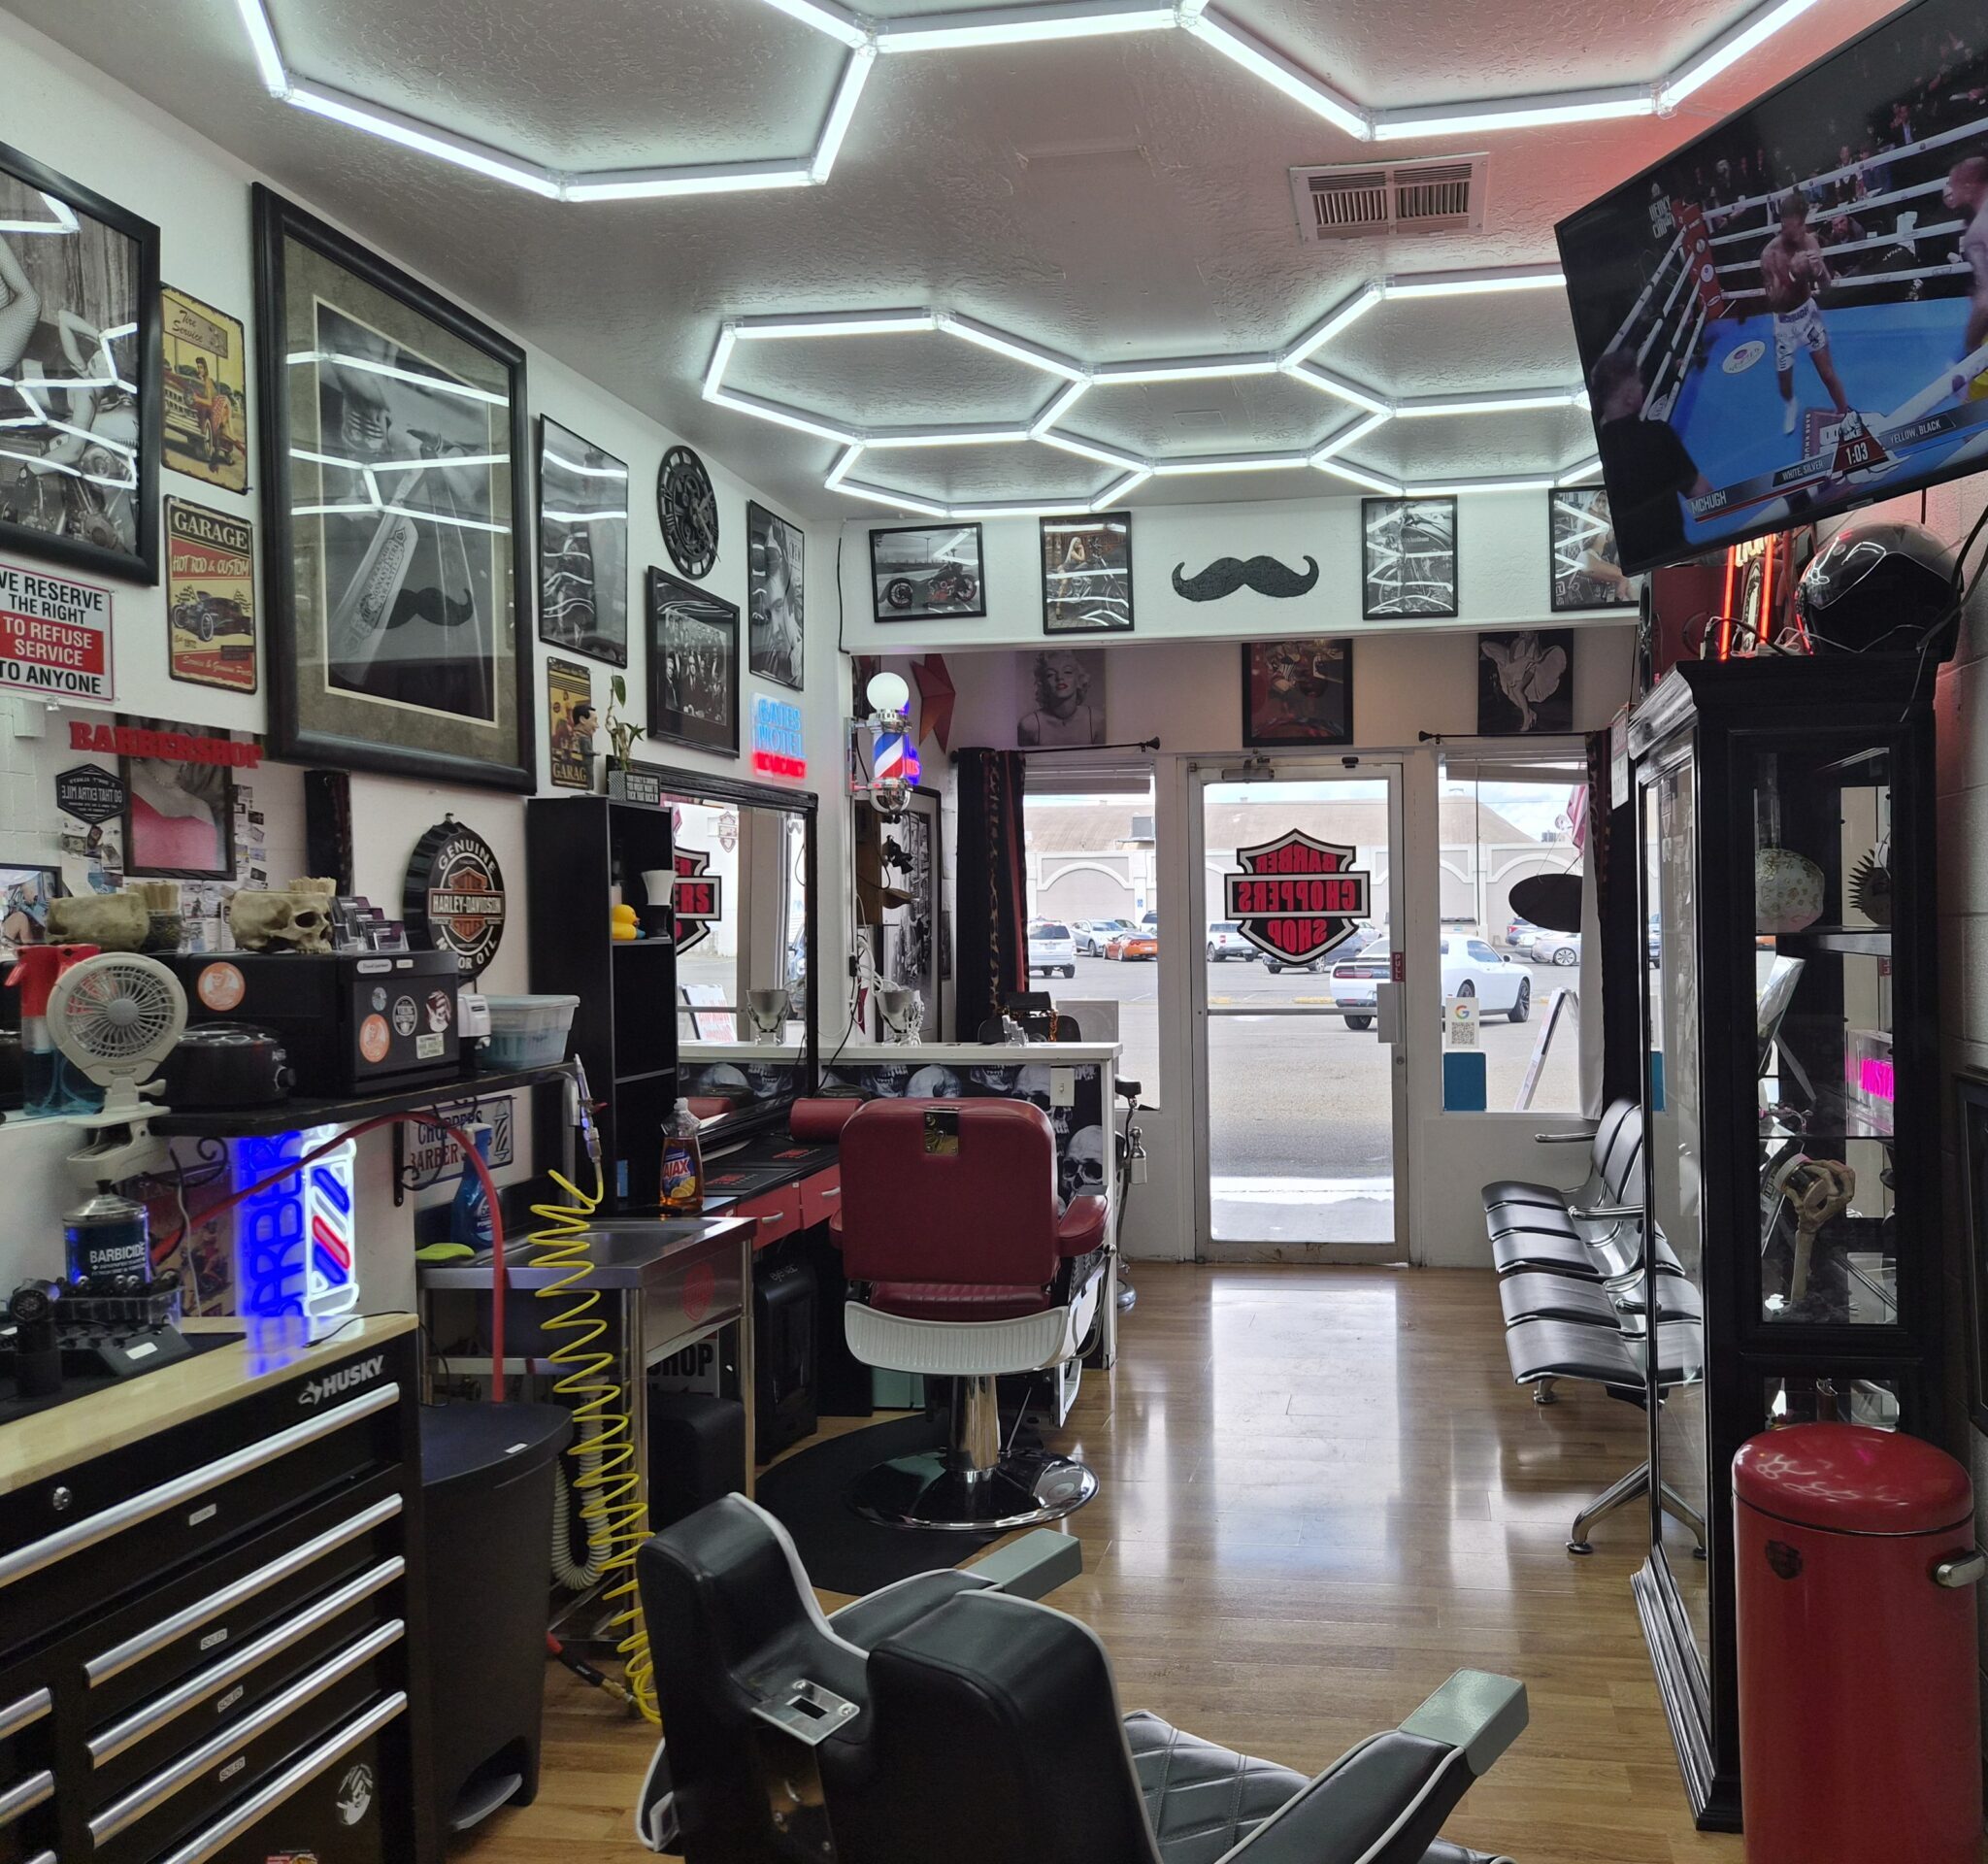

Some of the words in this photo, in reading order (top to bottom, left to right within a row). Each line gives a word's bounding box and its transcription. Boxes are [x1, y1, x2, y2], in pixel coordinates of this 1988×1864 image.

[172, 319, 203, 344] Service
[1918, 418, 1941, 436] BLACK
[1845, 442, 1869, 466] 1:03
[1781, 466, 1804, 482] WHITE,
[1803, 459, 1824, 475] SILVER
[1691, 489, 1727, 515] MCHUGH
[174, 511, 248, 550] GARAGE
[172, 553, 189, 573] HOT
[208, 559, 215, 572] &
[216, 557, 250, 577] CUSTOM
[24, 576, 103, 613] RESERVE
[8, 593, 38, 616] THE
[42, 601, 86, 625] RIGHT
[2, 616, 26, 637] TO
[30, 621, 93, 650] REFUSE
[15, 639, 83, 667] SERVICE
[0, 659, 20, 682] TO
[25, 665, 102, 695] ANYONE
[68, 721, 266, 770] BARBERSHOP
[758, 722, 806, 759] MOTEL
[552, 762, 587, 782] GARAG
[439, 840, 497, 875] GENUINE
[433, 894, 502, 914] HARLEY-DAVIDSON
[477, 940, 497, 965] OIL
[663, 1157, 690, 1179] AJAX
[89, 1242, 146, 1264] BARBICIDE
[322, 1354, 384, 1398] HUSKY
[202, 1631, 226, 1648] SOILED
[220, 1759, 245, 1781] SOILED
